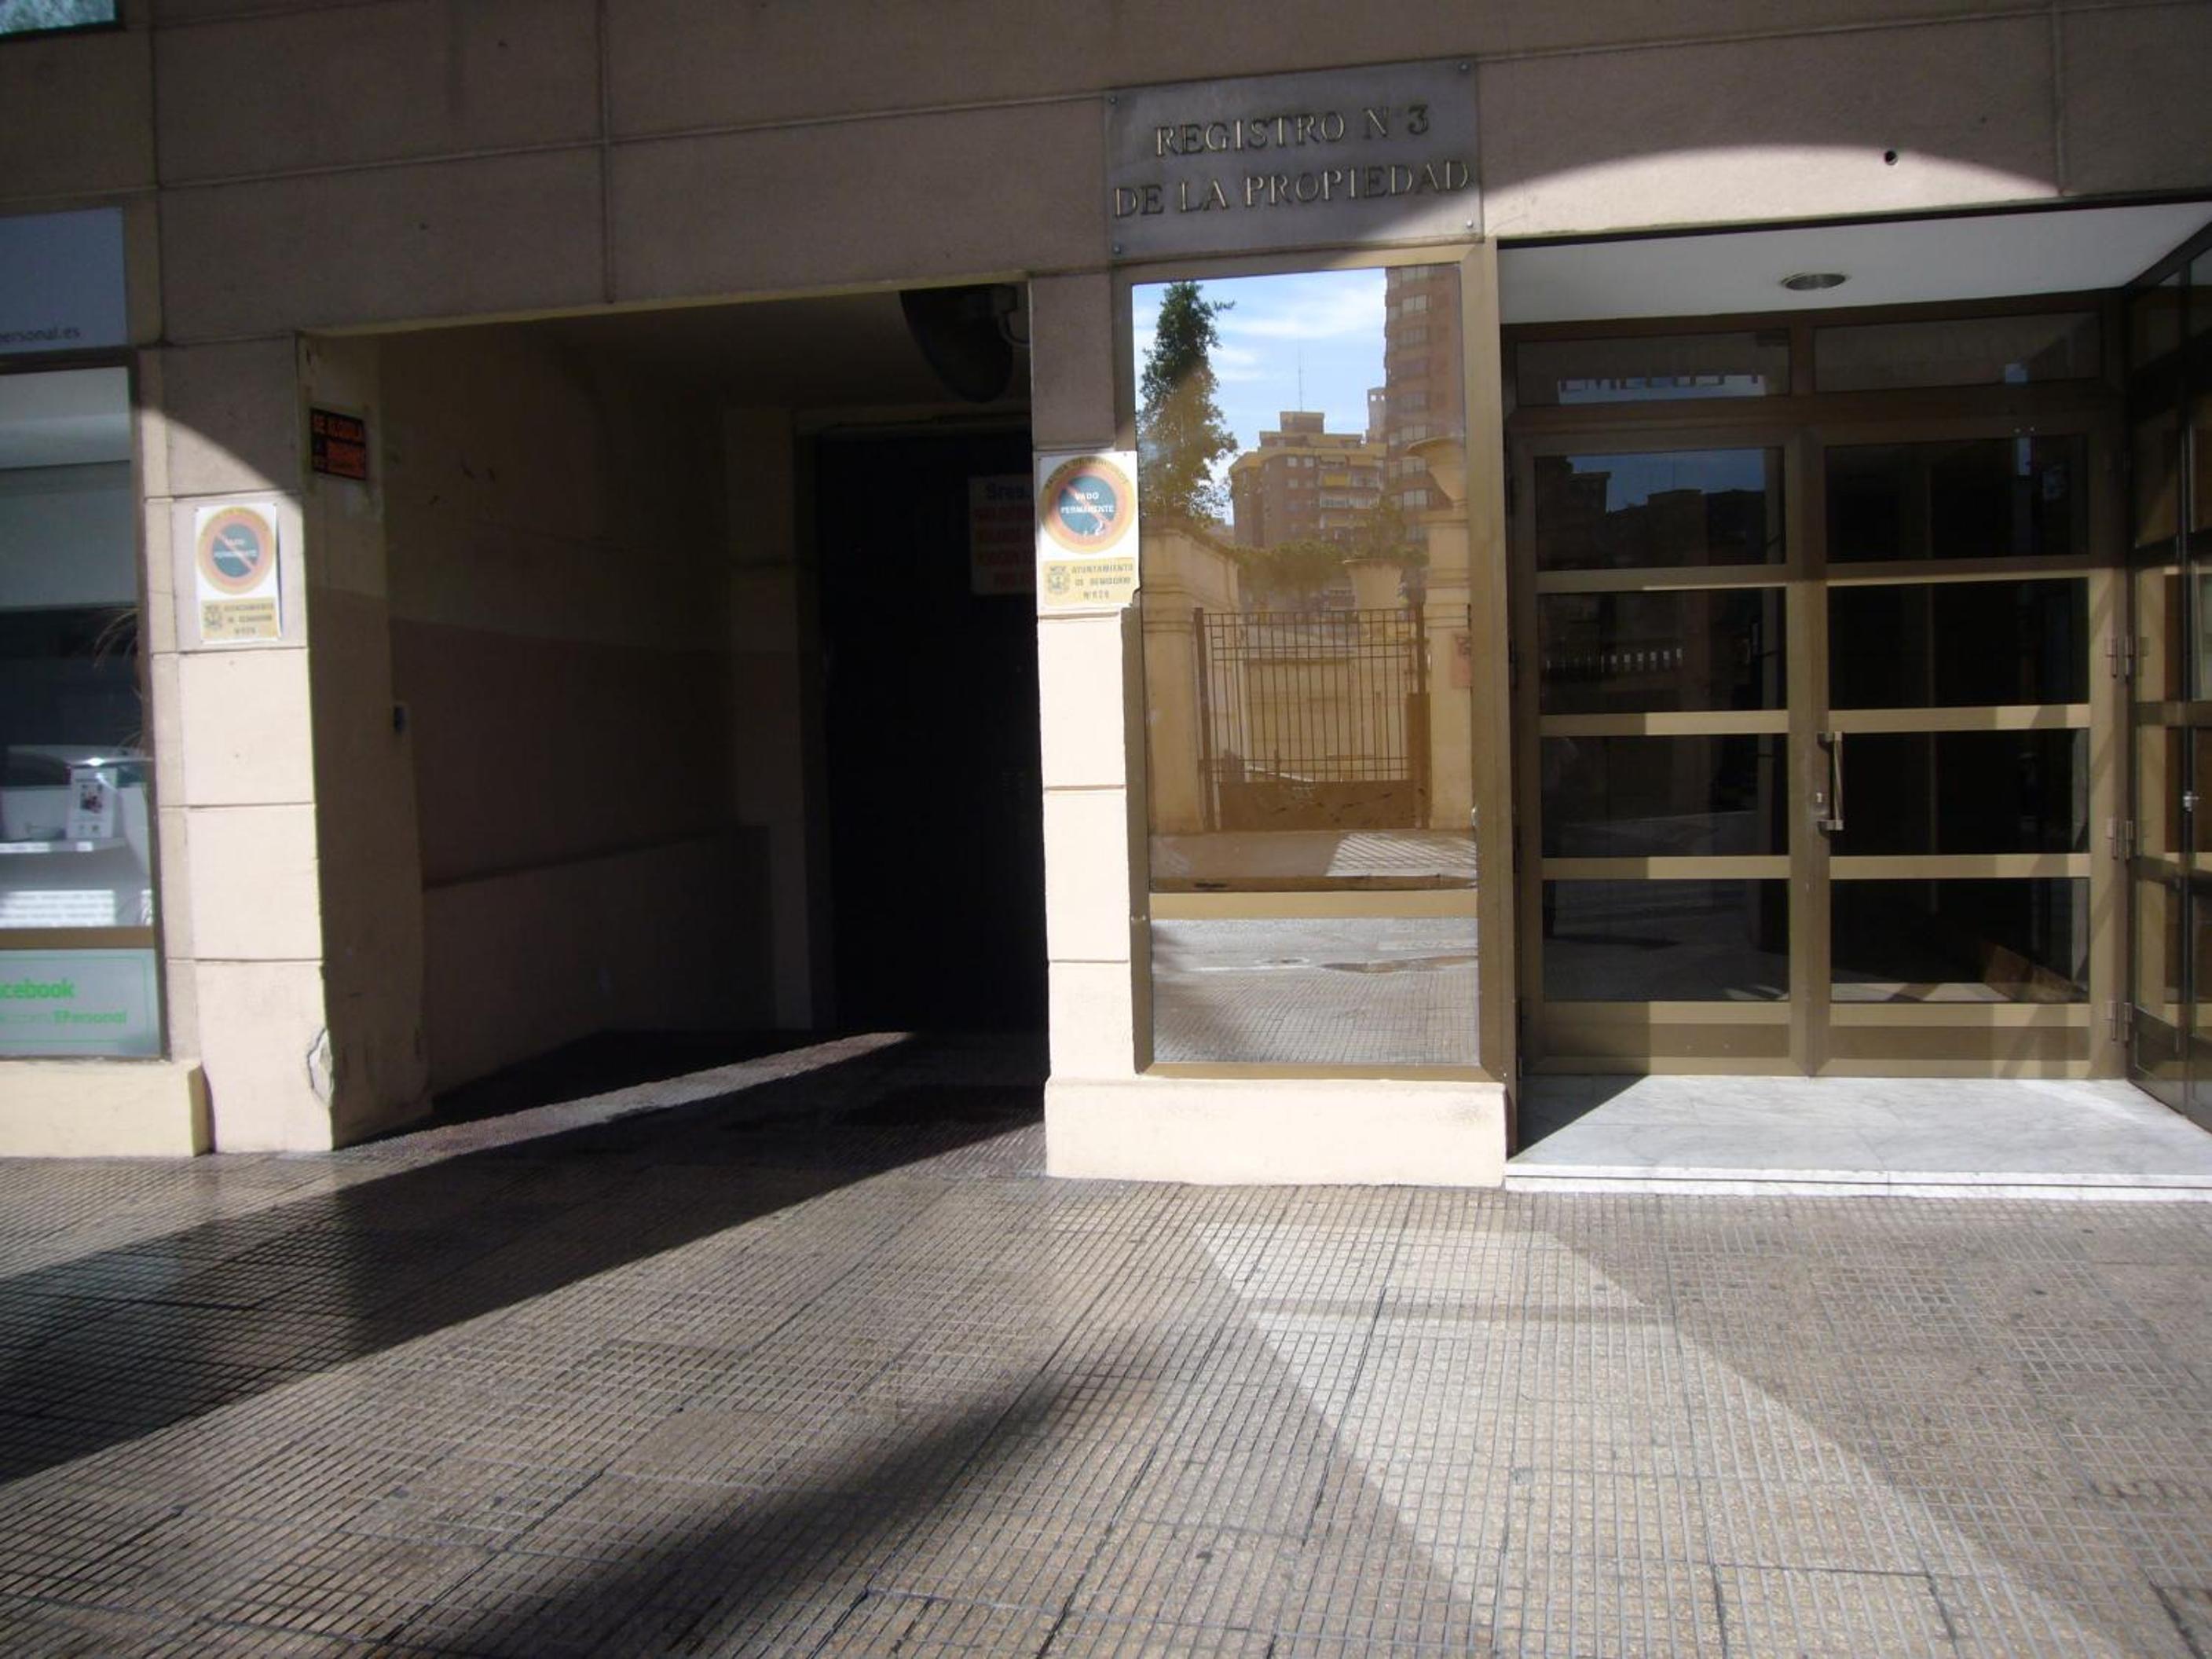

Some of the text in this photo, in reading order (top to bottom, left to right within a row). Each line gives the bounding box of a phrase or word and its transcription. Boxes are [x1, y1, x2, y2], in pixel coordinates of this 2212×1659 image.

[1155, 111, 1345, 157] REGISTRO
[1408, 103, 1430, 136] 3
[1113, 160, 1470, 218] DE LA PROPIEDAD
[1060, 504, 1115, 515] PERMANENTE
[1074, 492, 1100, 501] VADO
